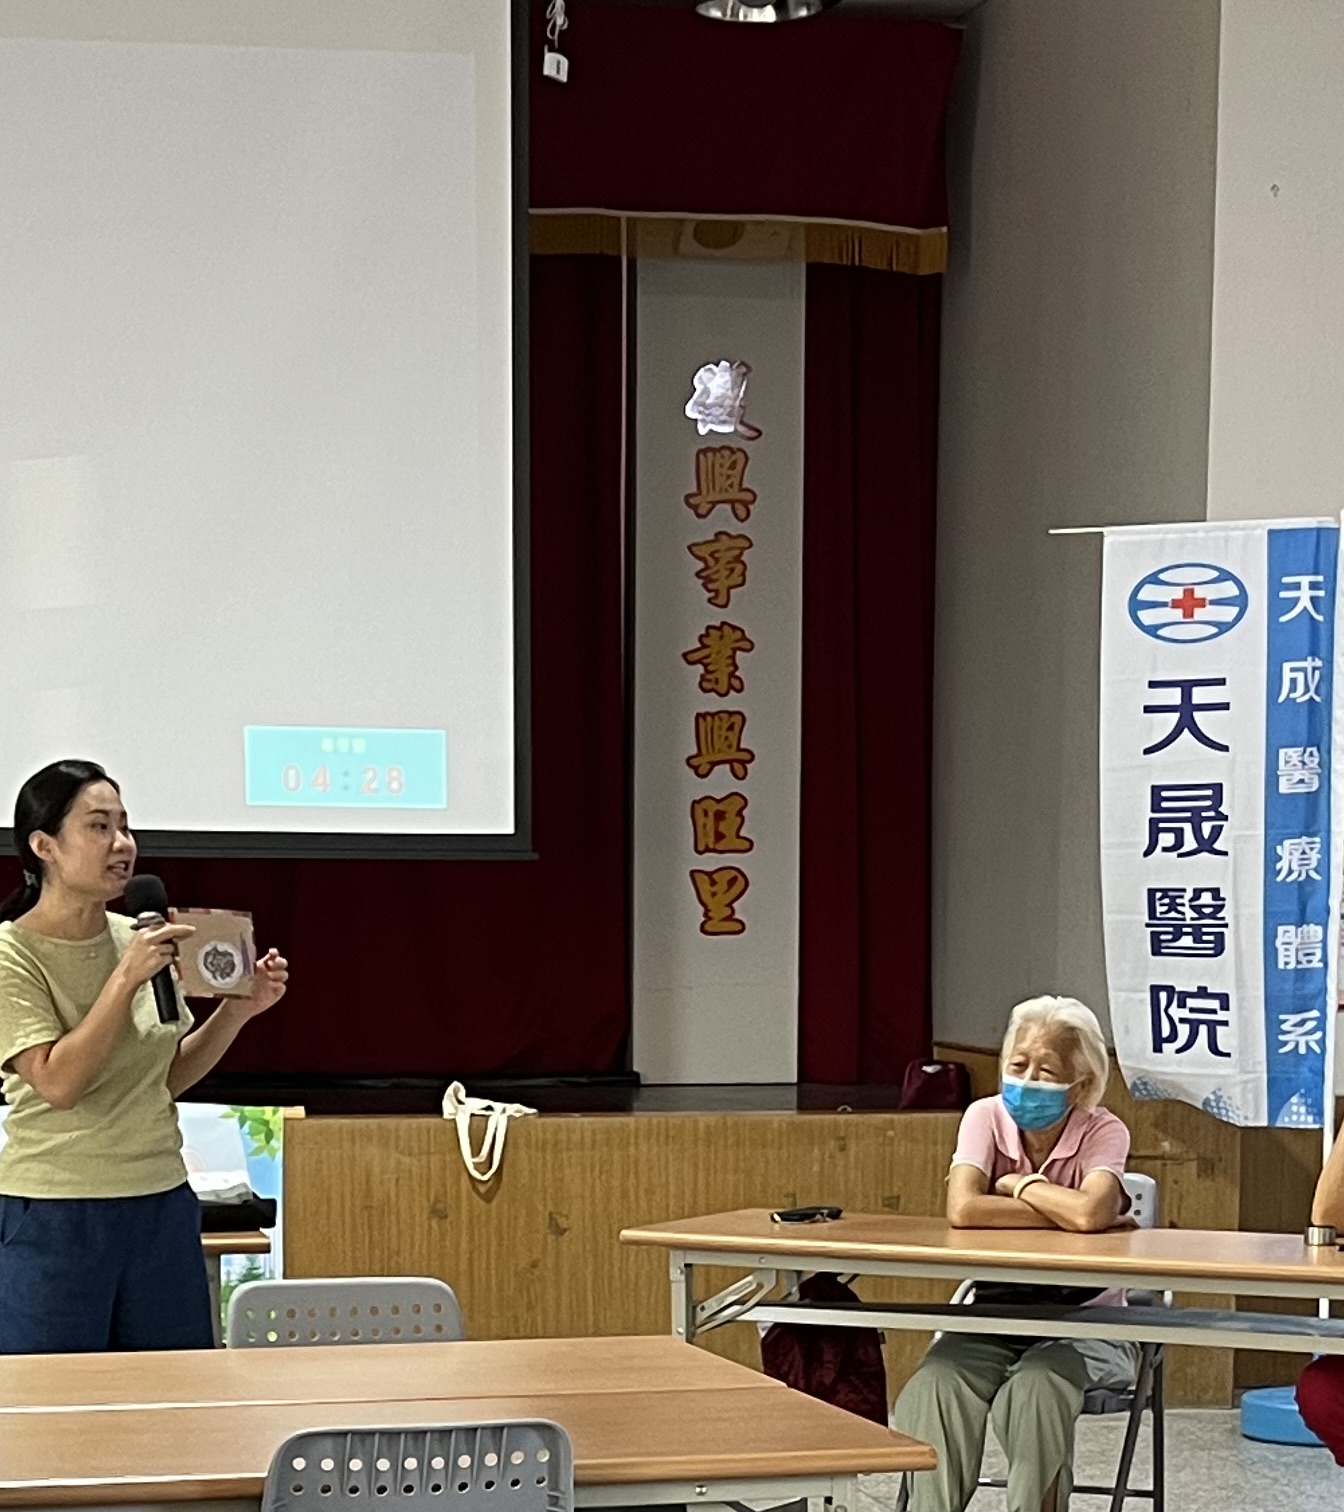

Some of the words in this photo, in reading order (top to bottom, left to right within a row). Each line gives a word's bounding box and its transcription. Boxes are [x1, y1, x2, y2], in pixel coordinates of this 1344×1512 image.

[1142, 677, 1232, 1058] 天晟醫院
[1273, 574, 1326, 1056] 天成醫療體系
